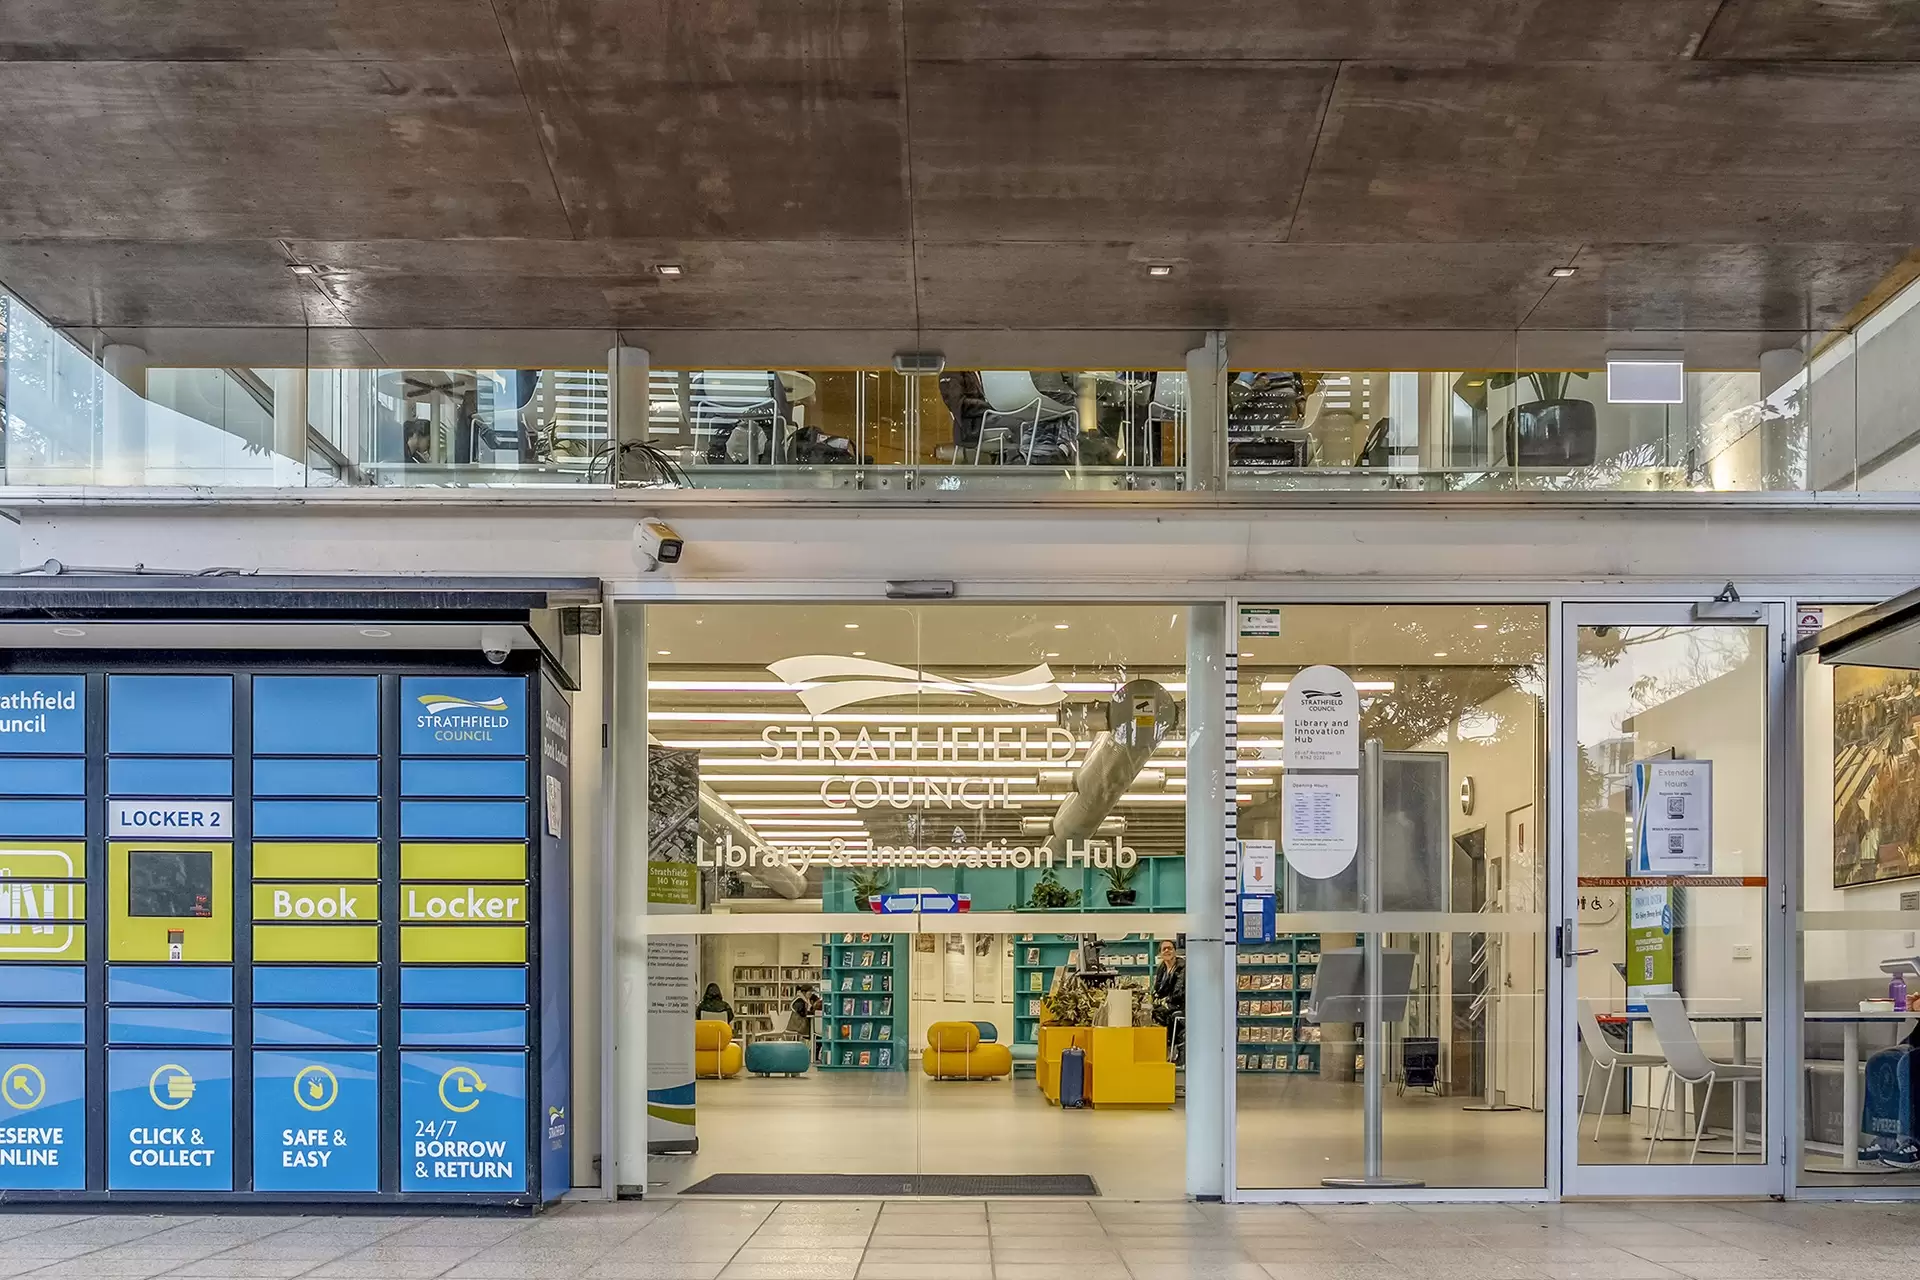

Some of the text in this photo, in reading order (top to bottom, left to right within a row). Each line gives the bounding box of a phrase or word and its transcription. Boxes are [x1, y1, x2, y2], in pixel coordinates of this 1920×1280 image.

[0, 691, 75, 709] athfield
[417, 716, 509, 728] STRATHFIELD
[1294, 719, 1349, 728] Library and
[434, 730, 492, 741] COUNCIL
[760, 725, 1076, 761] STRATHFIELD
[1658, 768, 1694, 776] Extended
[1664, 780, 1688, 788] Hours
[820, 777, 1022, 809] COUNCIL
[121, 811, 220, 826] LOCKER 2
[696, 834, 1137, 876] Library & Innovation Hub
[650, 867, 689, 877] Strathfield:
[657, 876, 689, 886] 140 Years
[1600, 878, 1616, 886] FIRE
[1617, 878, 1644, 886] SAFETY
[274, 887, 357, 918] Book
[409, 887, 519, 918] Locker
[0, 1128, 63, 1144] ESERVE
[129, 1127, 204, 1145] CLICK &
[282, 1129, 347, 1146] SAFE &
[415, 1120, 457, 1140] 24/7
[0, 1149, 59, 1166] NLINE
[129, 1149, 215, 1167] COLLECT
[415, 1141, 507, 1158] BORROW
[282, 1150, 332, 1167] EASY
[415, 1161, 513, 1178] & RETURN
